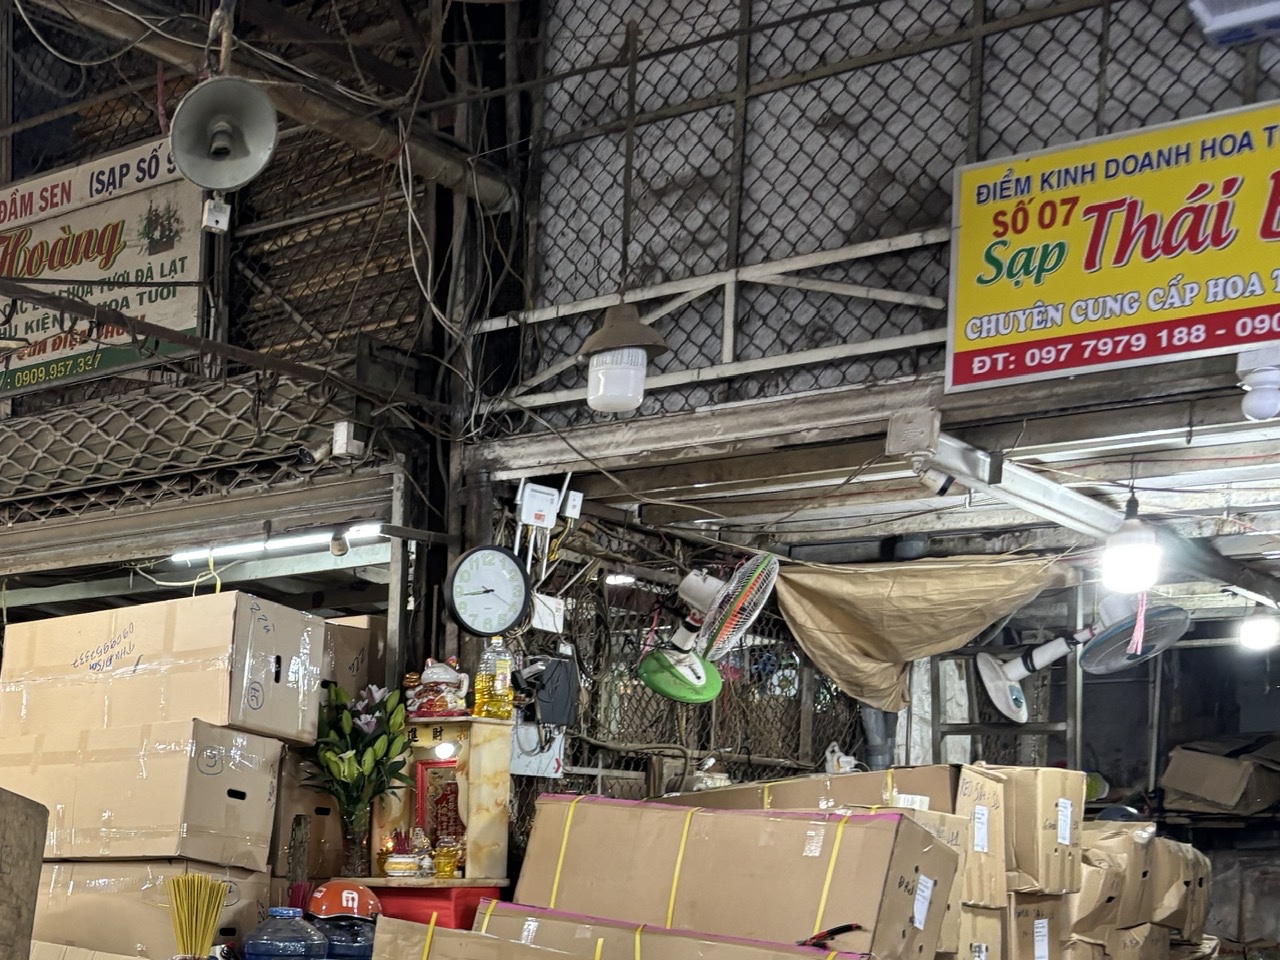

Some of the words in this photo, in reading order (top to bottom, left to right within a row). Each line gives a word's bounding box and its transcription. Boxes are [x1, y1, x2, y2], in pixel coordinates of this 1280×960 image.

[38, 179, 72, 212] SEN
[89, 163, 131, 198] (SẠP
[135, 143, 163, 183] SỐ
[975, 168, 1032, 205] ĐIỂM
[1040, 161, 1096, 192] KINH
[1104, 142, 1191, 180] DOANH
[1200, 130, 1254, 162] HOA
[975, 239, 1068, 287] Sạp
[1083, 176, 1243, 274] Thái
[992, 196, 1035, 238] SỐ
[1037, 196, 1081, 230] 07
[159, 256, 188, 279] LẠT
[965, 301, 1064, 341] CHUYÊN
[1070, 291, 1141, 325] CUNG
[1147, 274, 1201, 311] CẤP
[1207, 272, 1264, 305] HOA
[972, 352, 1017, 376] ĐT:
[1024, 343, 1072, 368] 097
[1080, 333, 1147, 359] 7979
[1156, 324, 1207, 348] 188
